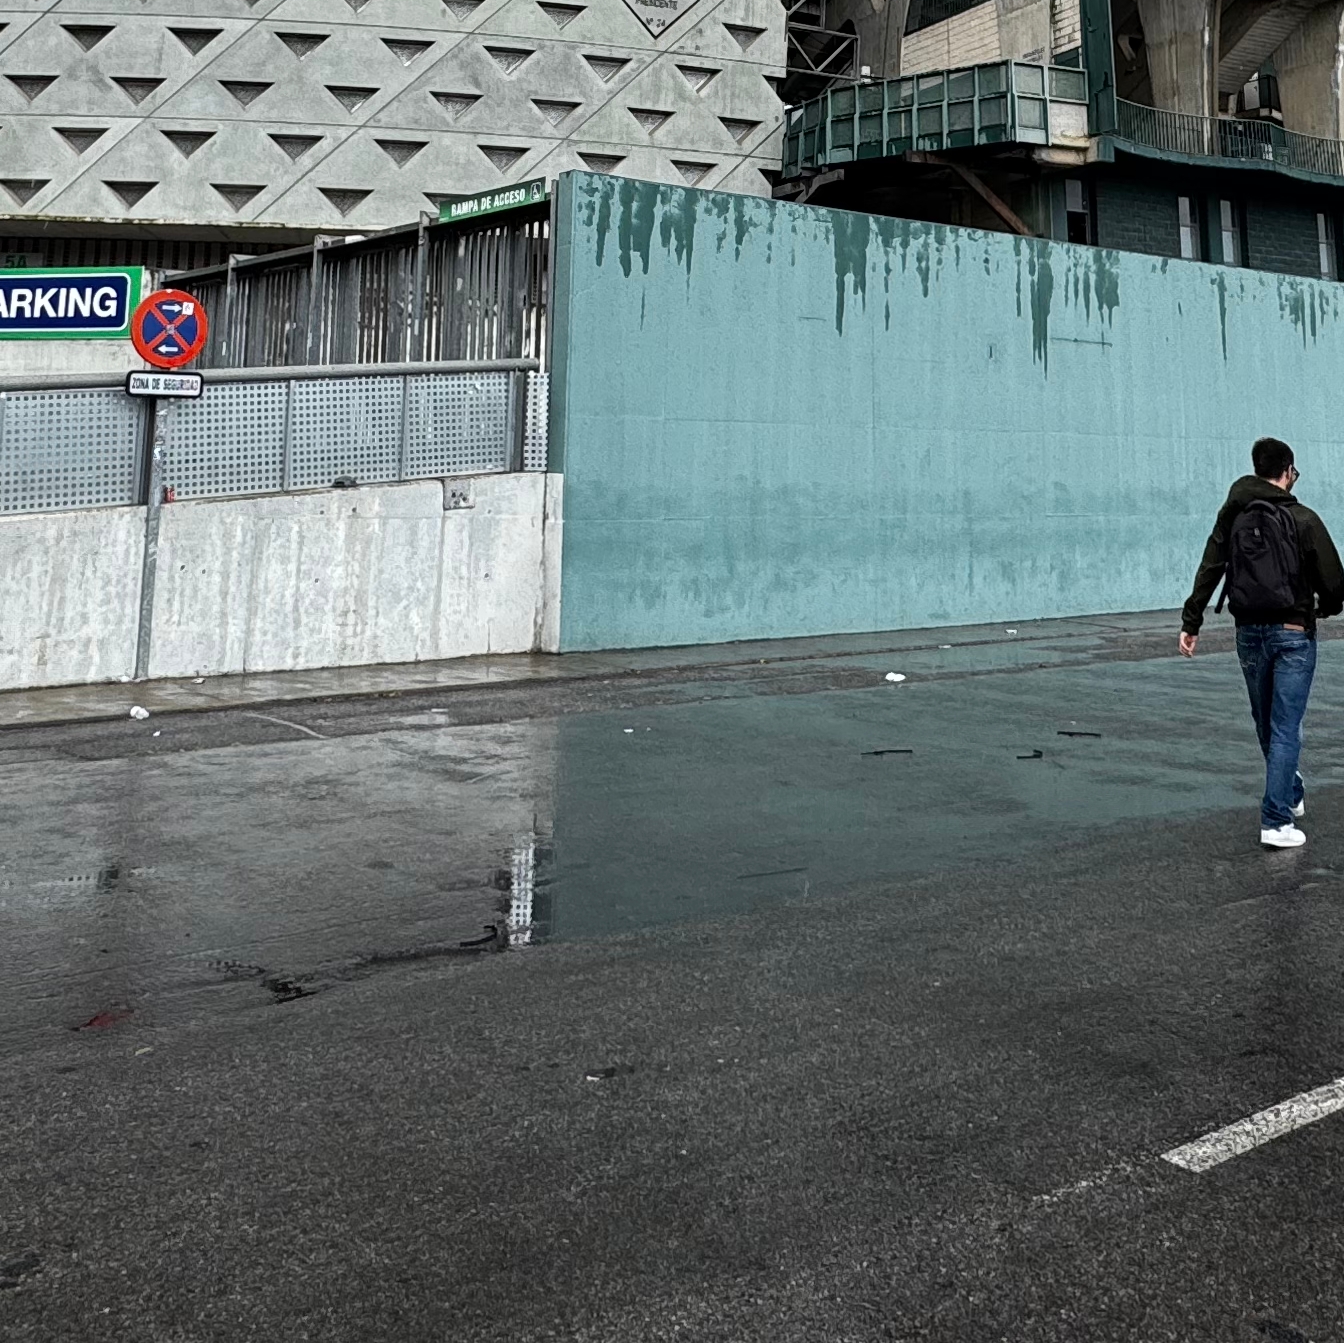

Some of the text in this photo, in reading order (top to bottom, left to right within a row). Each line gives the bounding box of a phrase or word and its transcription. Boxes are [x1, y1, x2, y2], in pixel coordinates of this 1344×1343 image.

[451, 189, 525, 217] RAMPA DE ACCESO
[131, 377, 149, 390] ZONA
[151, 378, 161, 390] DE
